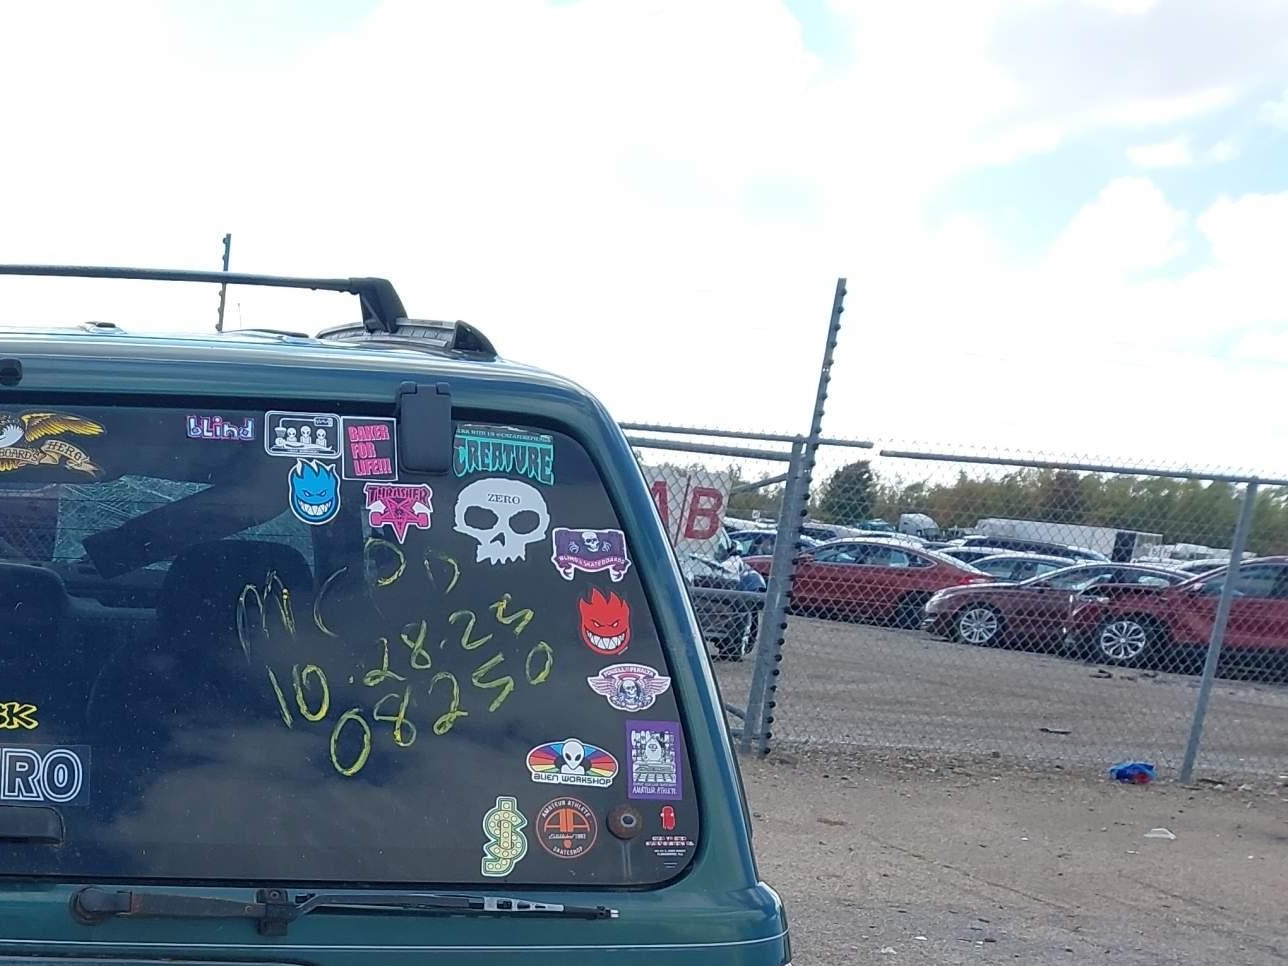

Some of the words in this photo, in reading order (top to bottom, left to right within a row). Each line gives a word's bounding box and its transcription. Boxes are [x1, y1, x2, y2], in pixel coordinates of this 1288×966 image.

[348, 425, 390, 441] BAKER
[48, 441, 82, 460] HERO
[351, 442, 376, 459] FOR
[453, 437, 554, 486] CREATURE
[367, 486, 432, 509] THRASHER
[487, 493, 520, 504] ZERO
[533, 773, 559, 782] ALIEN
[561, 775, 611, 786] WORKSHOP
[541, 800, 566, 818] AMATEUR
[567, 800, 591, 818] ATHLETE
